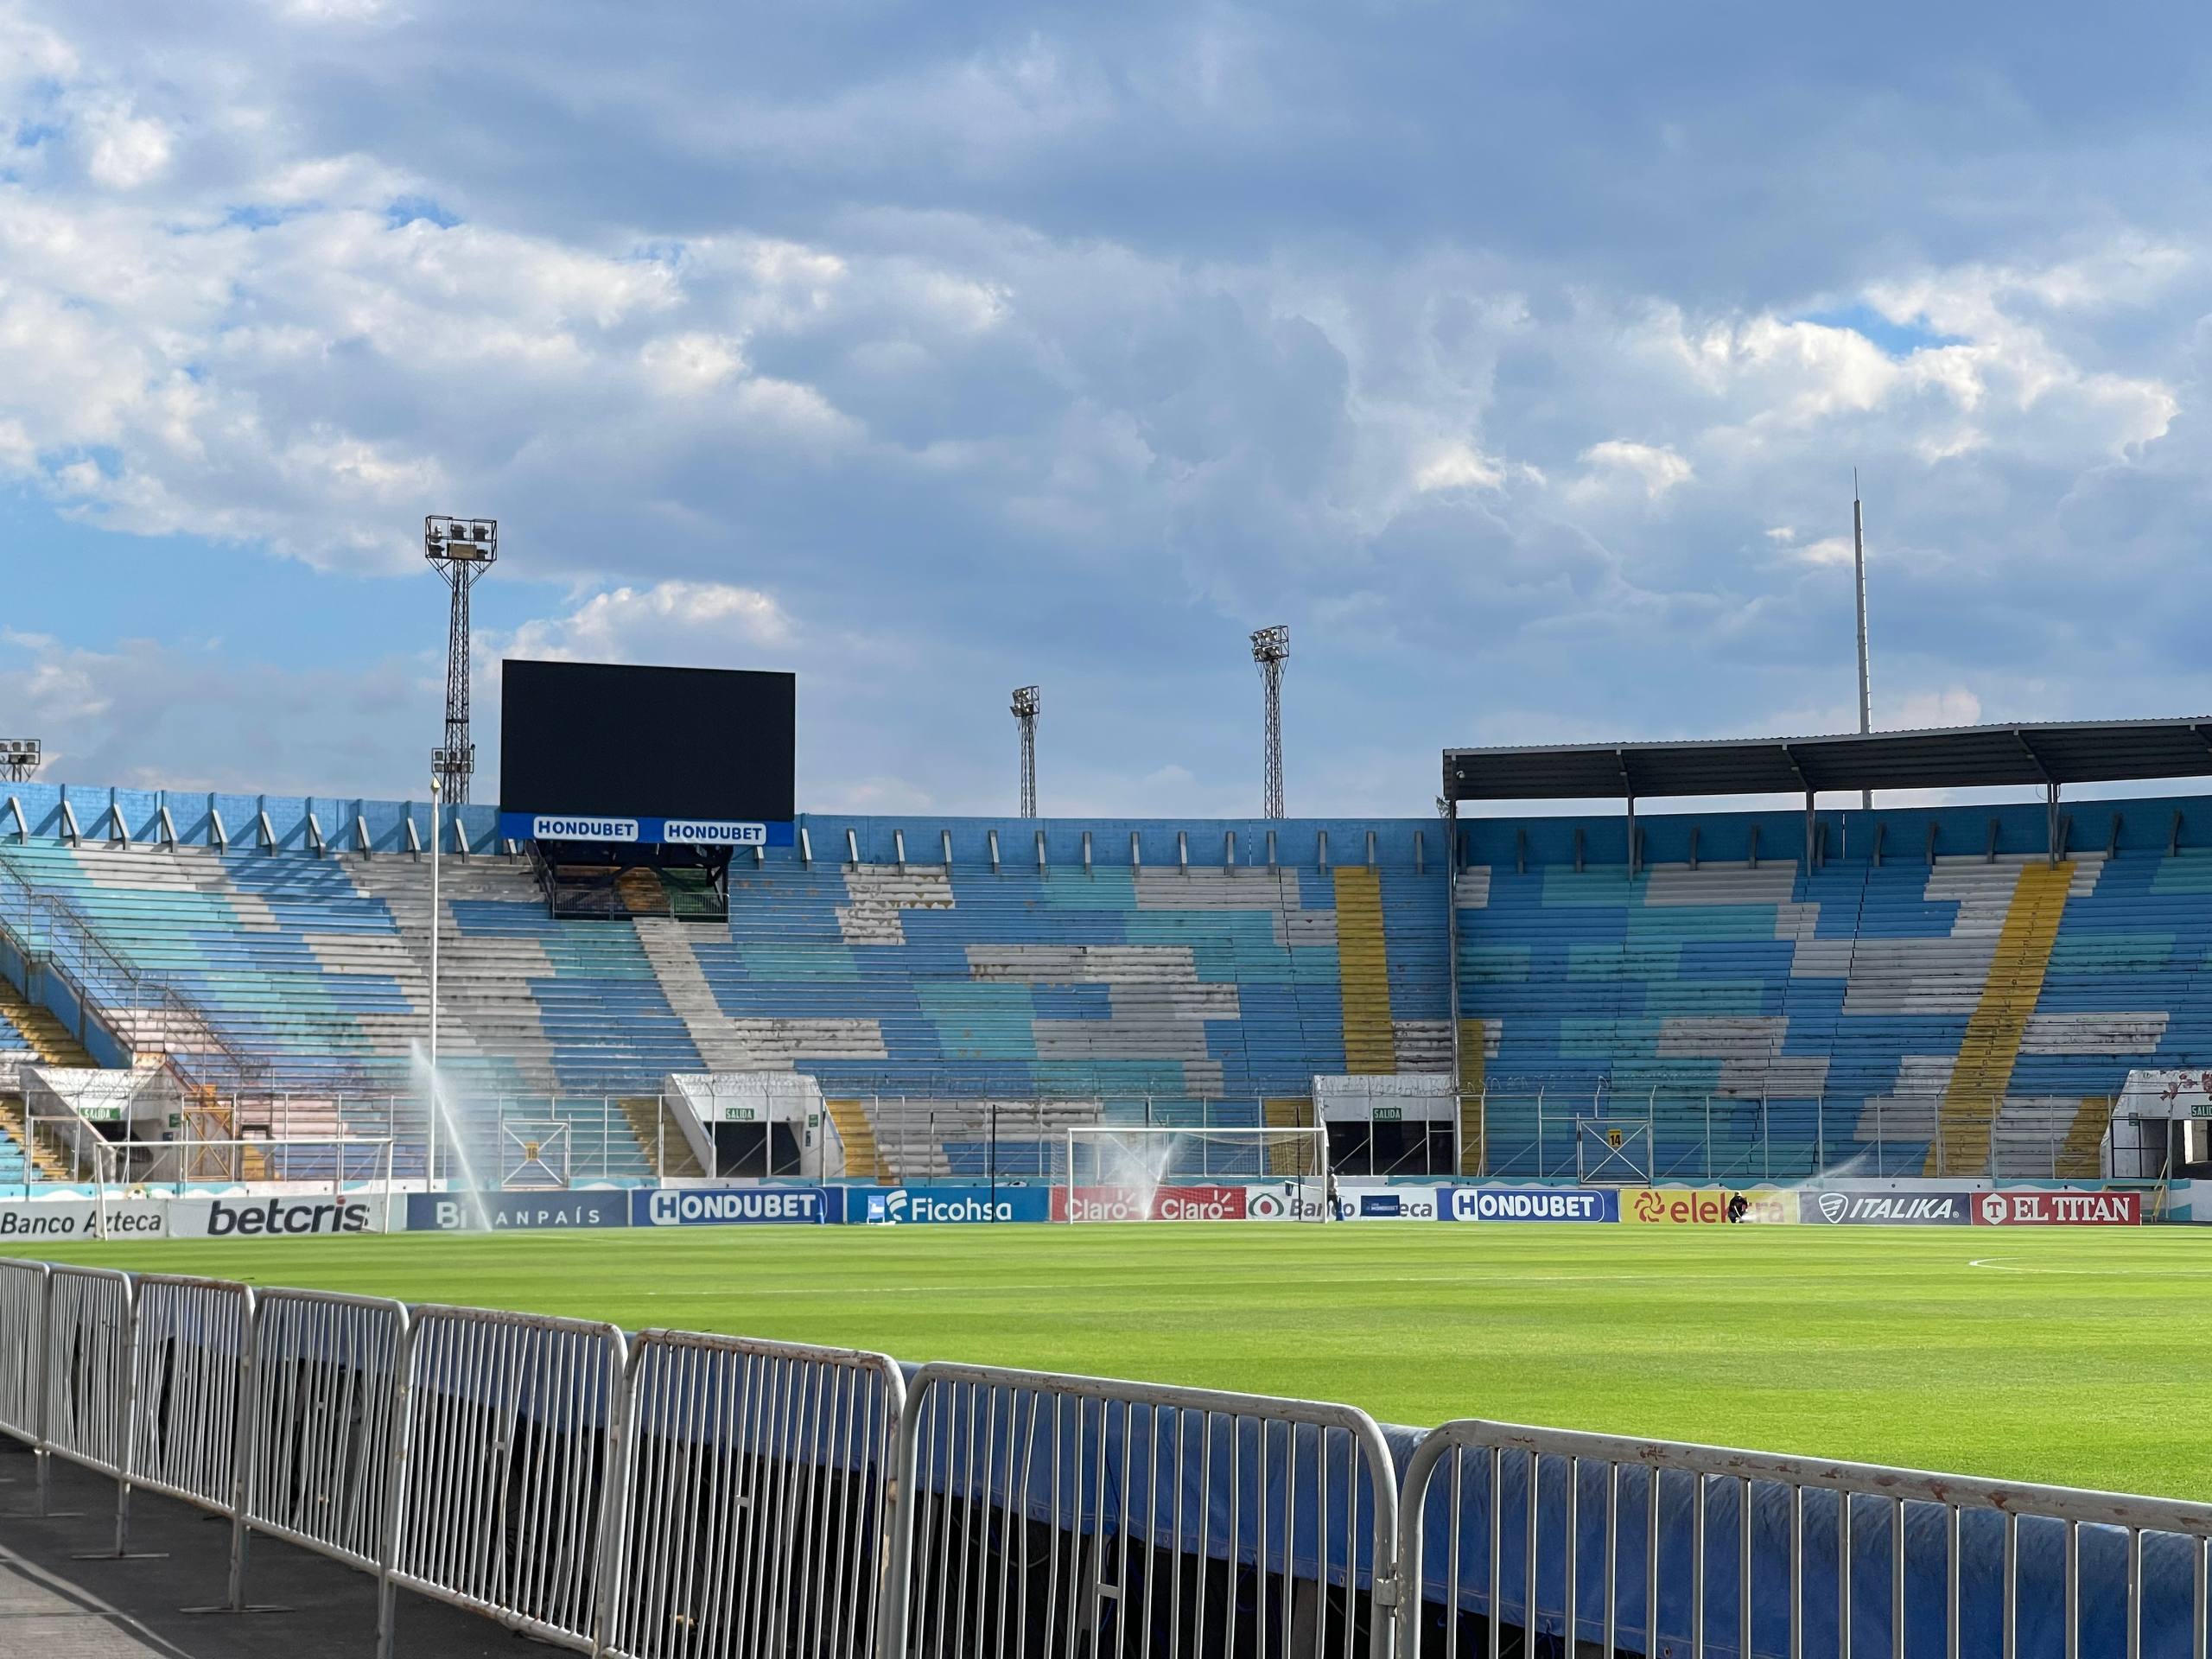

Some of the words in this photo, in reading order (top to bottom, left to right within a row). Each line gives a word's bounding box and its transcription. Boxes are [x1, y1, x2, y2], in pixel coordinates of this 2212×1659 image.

[538, 820, 634, 836] HONDUBET
[669, 824, 762, 840] HONDUBET
[84, 1108, 111, 1120] SALIDA
[726, 1109, 753, 1119] SALIDA
[1374, 1109, 1401, 1119] SALIDA
[2191, 1105, 2212, 1116] SALID
[1610, 1134, 1621, 1146] 14
[527, 1147, 537, 1159] 16
[207, 1195, 369, 1236] betcris
[496, 1205, 601, 1225] ANPAÍS
[657, 1194, 817, 1219] HONDUBET
[912, 1198, 1012, 1221] Ficohsa
[1065, 1198, 1128, 1220] Claro
[1160, 1198, 1224, 1220] Claro
[1458, 1194, 1594, 1217] HONDUBET
[1848, 1198, 1953, 1218] ITALIKA
[2013, 1197, 2049, 1221] EL
[2051, 1197, 2130, 1221] TITAN
[1, 1211, 75, 1234] Banco
